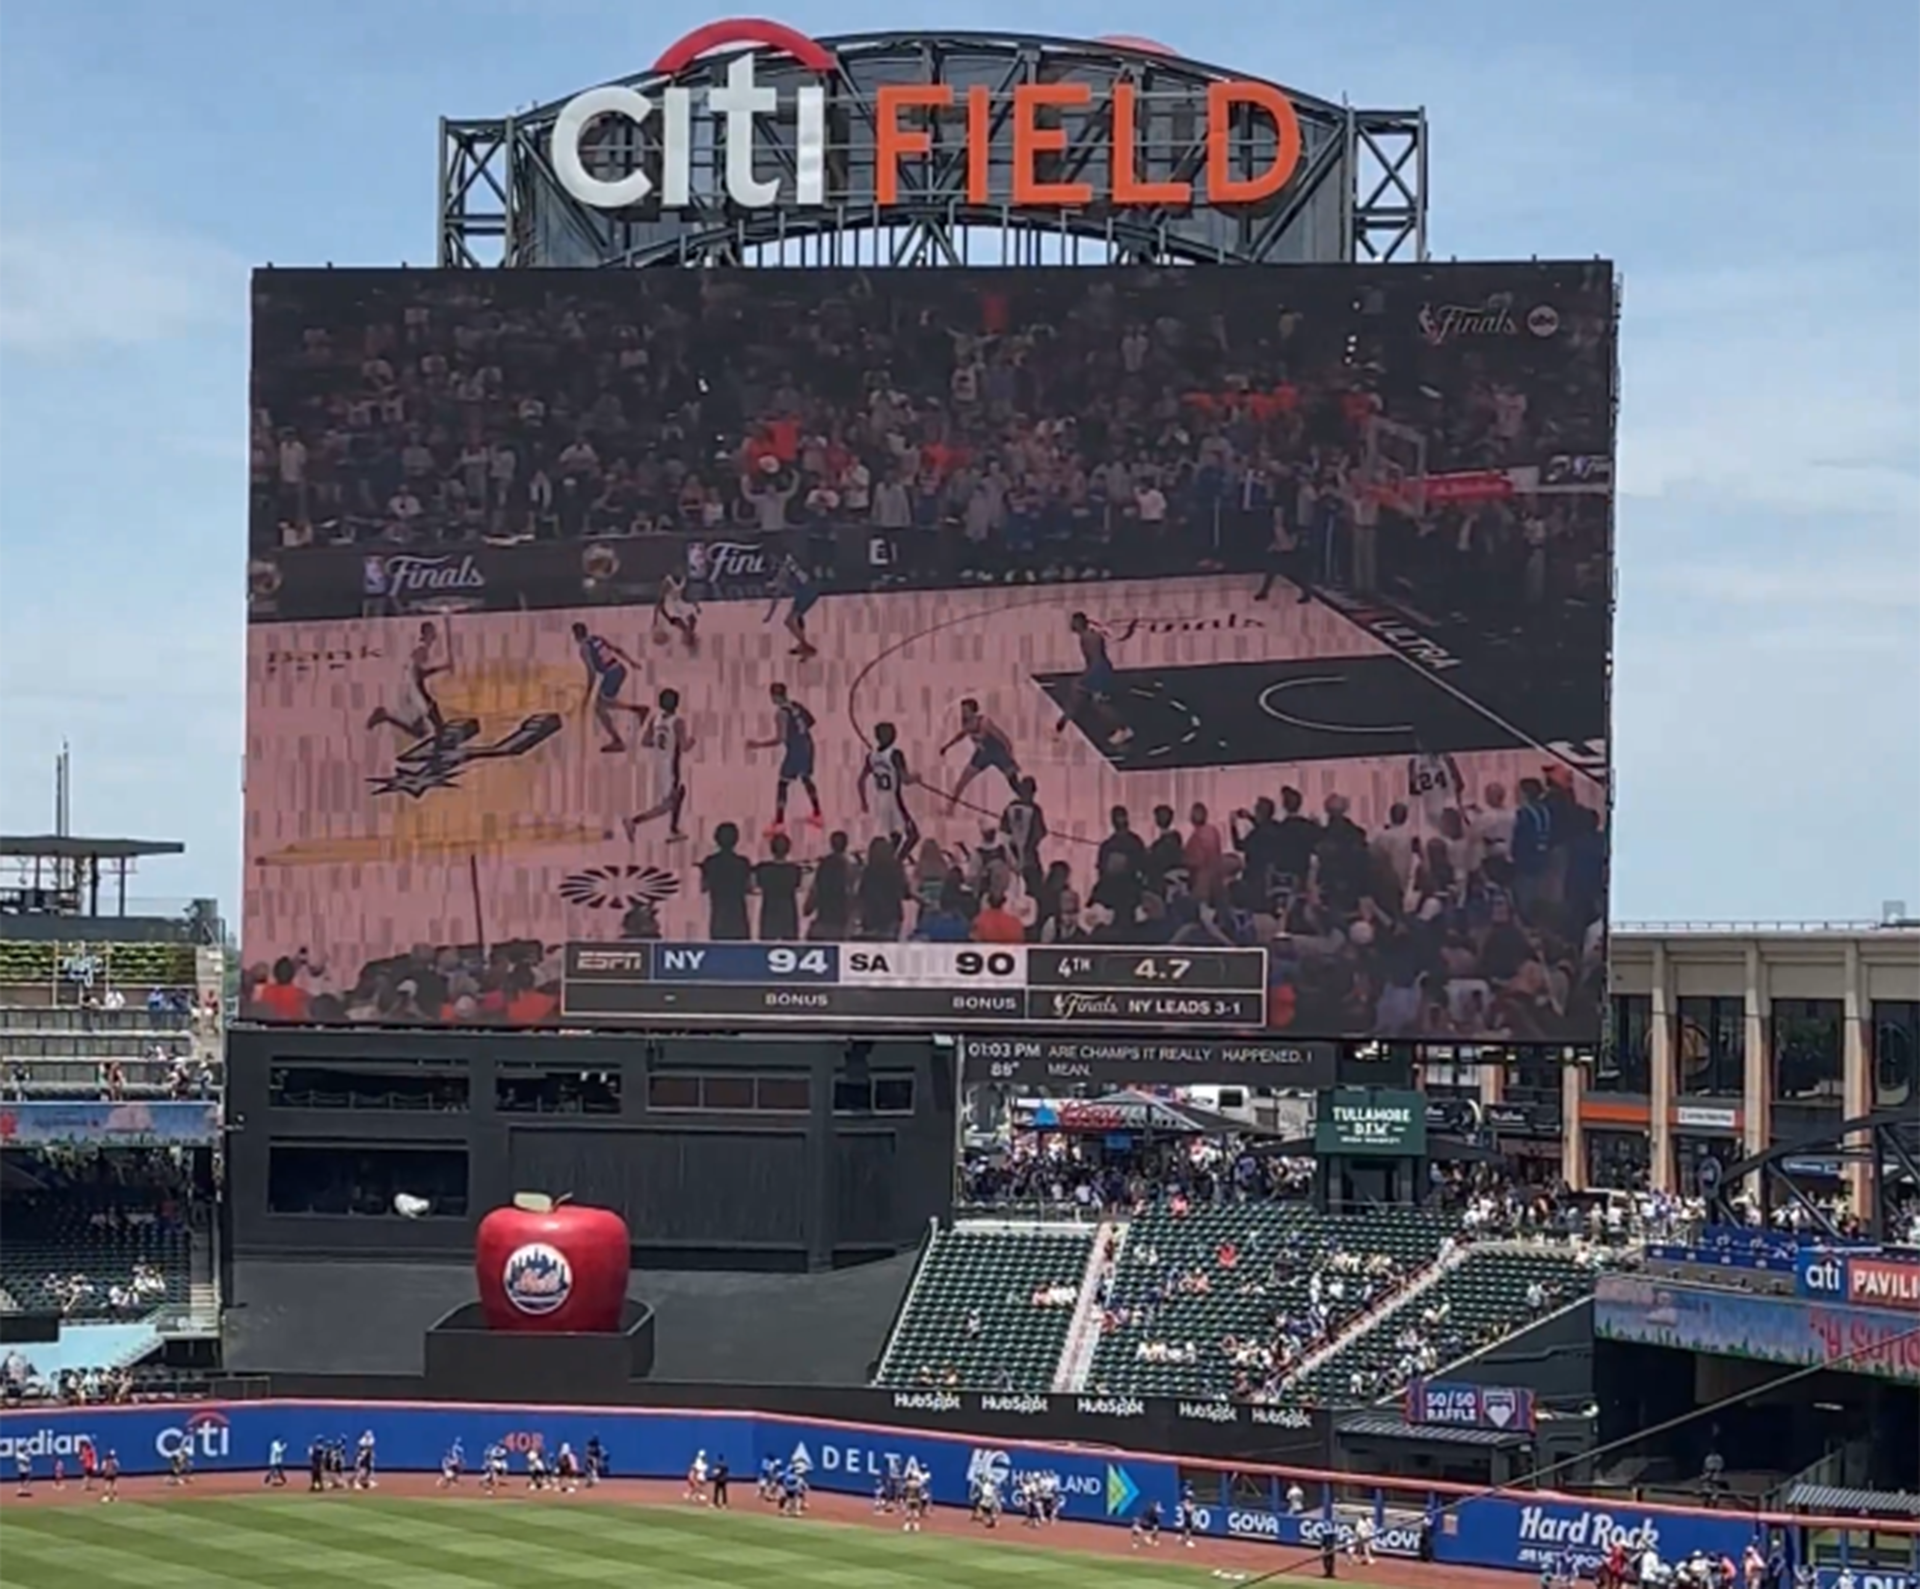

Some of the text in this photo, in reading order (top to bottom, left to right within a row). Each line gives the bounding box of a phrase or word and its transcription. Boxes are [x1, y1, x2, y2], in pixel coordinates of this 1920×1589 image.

[551, 53, 1301, 207] citi FIELD
[1436, 304, 1519, 346] Finals
[384, 555, 485, 597] Finals
[1370, 620, 1462, 669] ULTRA
[1418, 770, 1448, 791] 24
[576, 948, 1191, 980] ESPN NY 94 SA 90 4TH 4.7
[765, 992, 1241, 1020] BONUS BONUS Finals NY LEADS 3-1
[968, 1042, 1041, 1058] 01:03 PM
[1049, 1045, 1077, 1058] ARE
[1079, 1045, 1139, 1060] CHAMPS
[1142, 1047, 1155, 1060] IT
[1159, 1047, 1211, 1062] REALLY
[1332, 1106, 1413, 1123] TULLAMORE
[894, 1391, 961, 1412] HubSpot
[982, 1394, 1048, 1413] HubSpot
[1077, 1398, 1145, 1416] HubSpot
[1426, 1390, 1476, 1409] 50/50
[1179, 1402, 1238, 1422] HubSpot
[1426, 1408, 1477, 1421] RAFFLE
[822, 1445, 922, 1480] DELTA
[1175, 1506, 1211, 1529] 30
[1228, 1511, 1279, 1534] GOYA
[1518, 1506, 1660, 1555] Hard Rock
